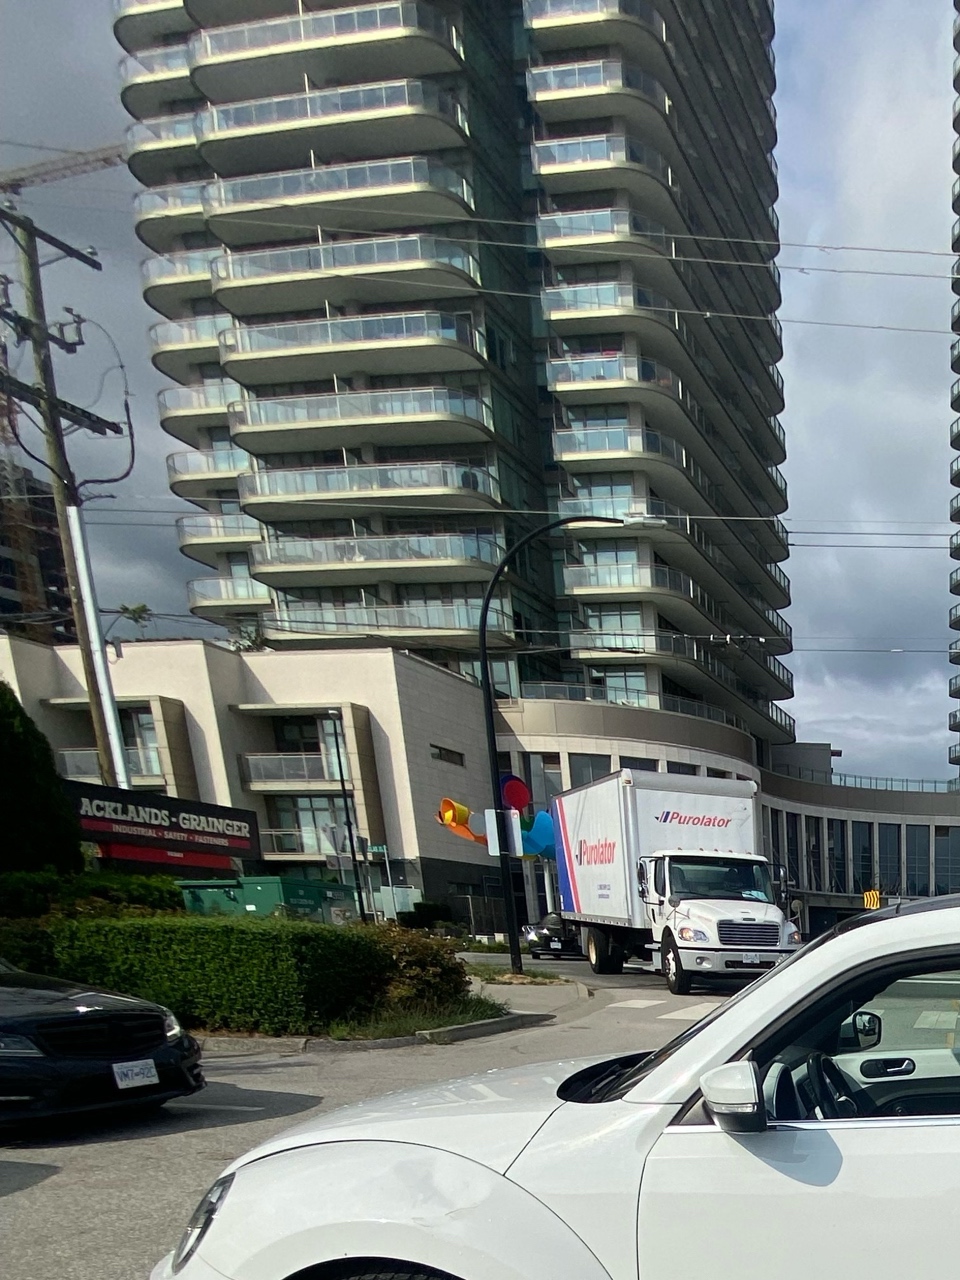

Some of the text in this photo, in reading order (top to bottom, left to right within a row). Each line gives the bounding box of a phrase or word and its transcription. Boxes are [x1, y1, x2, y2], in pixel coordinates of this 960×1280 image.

[80, 797, 170, 827] ACKLANDS
[179, 812, 251, 838] GRAINGER
[669, 811, 732, 828] Purolator
[112, 824, 229, 847] INDUSTRIAL SAFETY FASTENERS
[583, 837, 616, 866] Purolator
